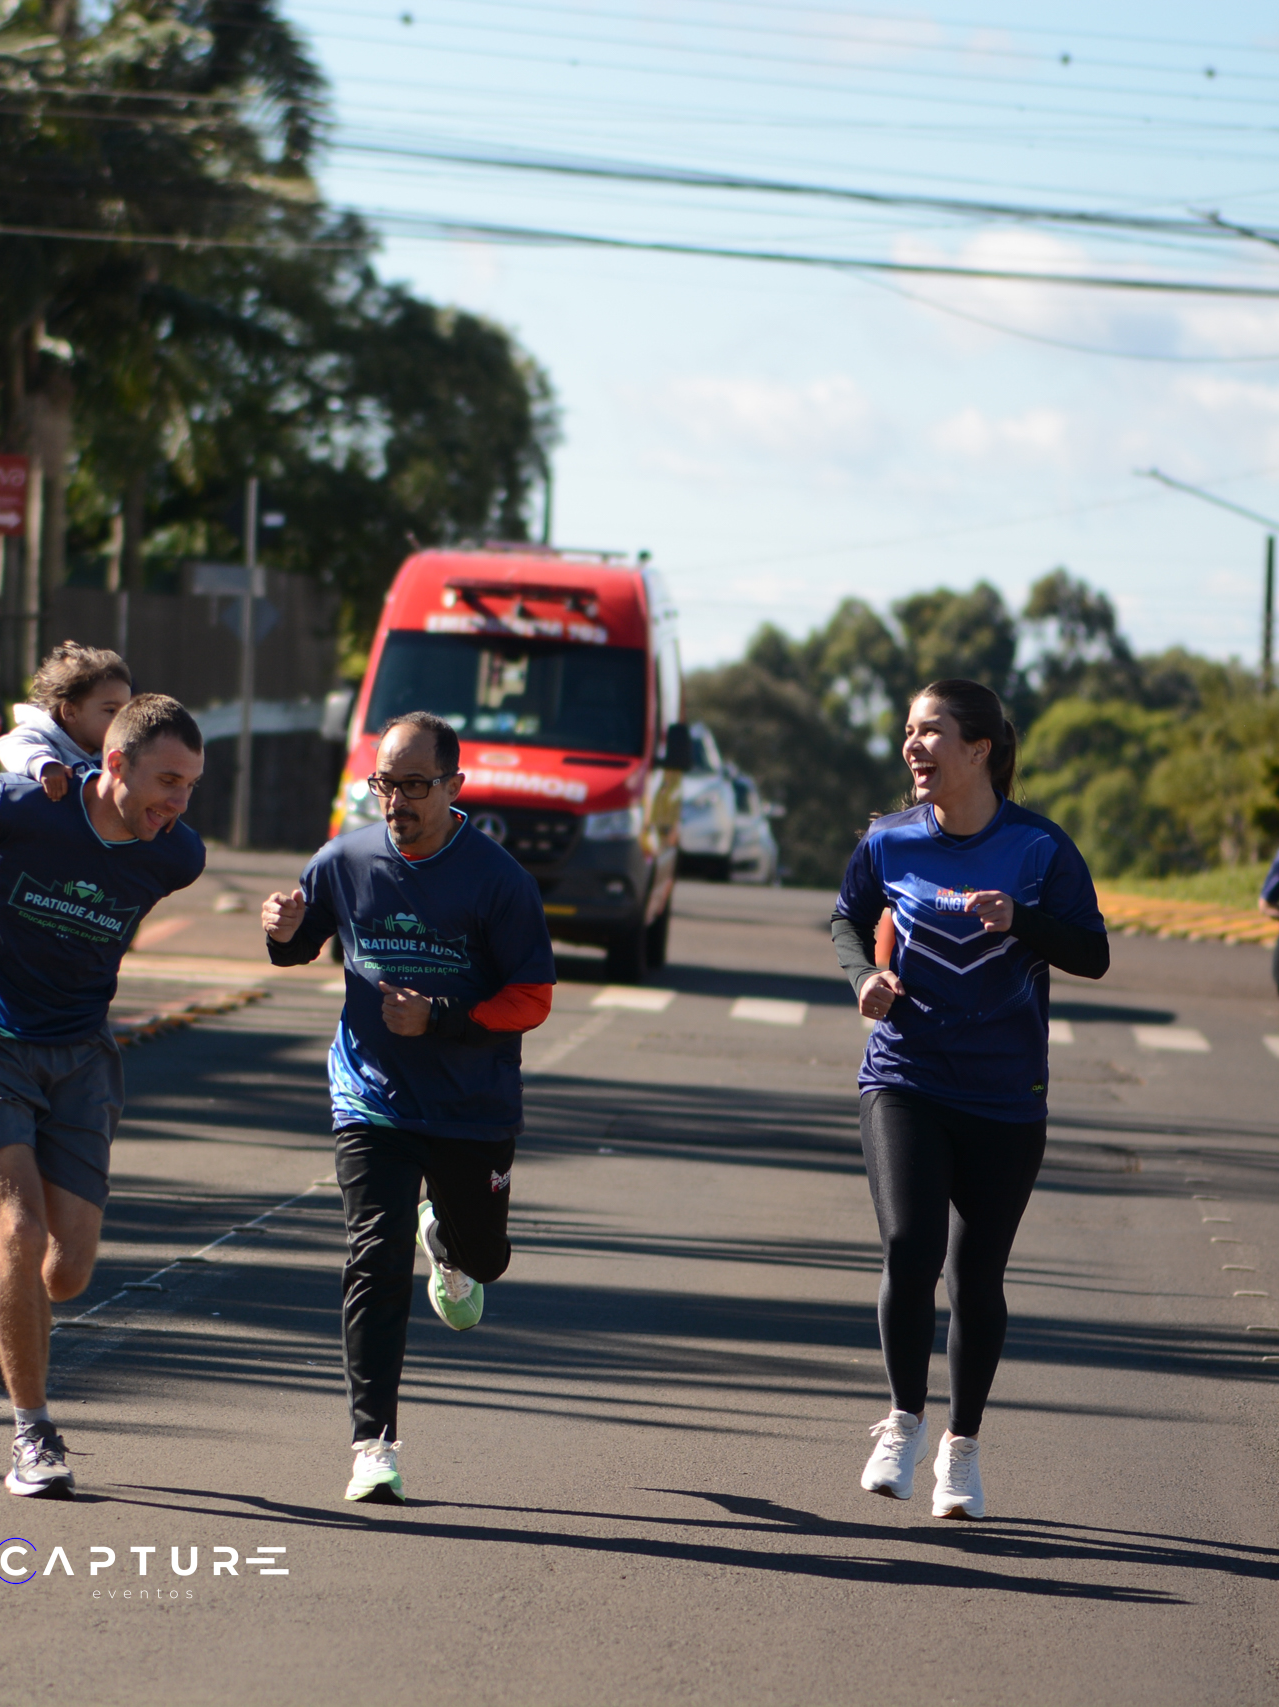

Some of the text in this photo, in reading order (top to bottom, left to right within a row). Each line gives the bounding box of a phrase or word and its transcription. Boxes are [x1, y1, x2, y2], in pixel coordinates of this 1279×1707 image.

[935, 896, 962, 911] ONG
[24, 892, 122, 932] PRATIQUE AJUDA
[397, 964, 423, 974] FÍSICA
